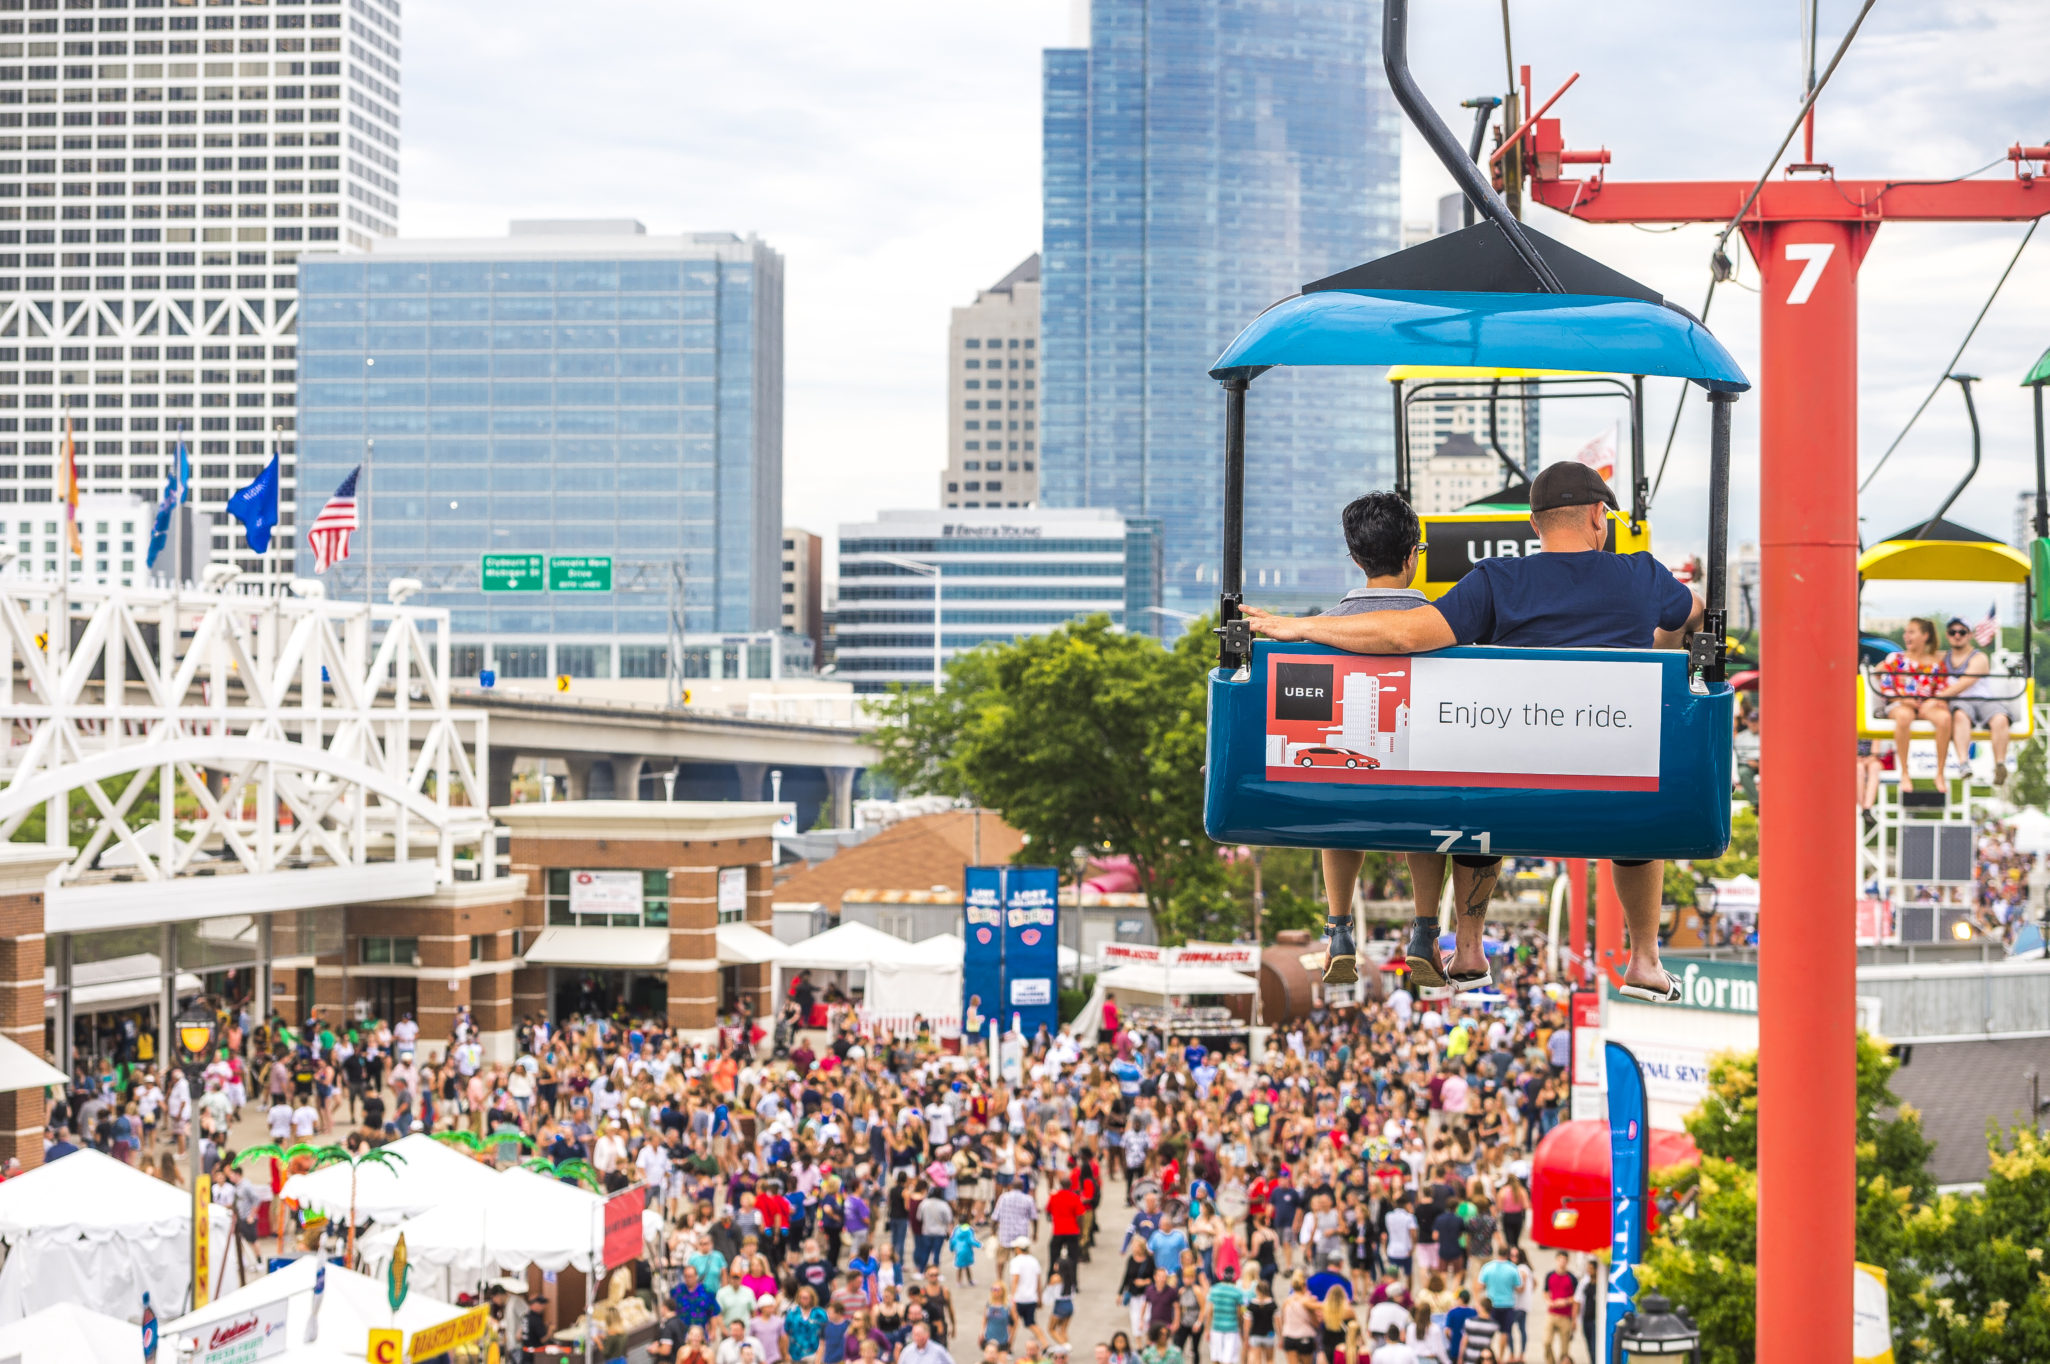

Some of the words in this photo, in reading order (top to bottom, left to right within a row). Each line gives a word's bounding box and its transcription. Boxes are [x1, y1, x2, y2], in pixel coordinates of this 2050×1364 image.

[1785, 243, 1835, 304] 7
[1467, 539, 1541, 564] UBE
[1285, 687, 1324, 698] UBER
[1439, 702, 1512, 729] Enjoy
[1522, 703, 1565, 726] the
[1576, 704, 1632, 728] ride.
[1430, 830, 1491, 854] 71
[1674, 963, 1758, 1011] form
[1675, 1065, 1707, 1085] SENT
[199, 1186, 208, 1299] CORN
[376, 1339, 395, 1364] C
